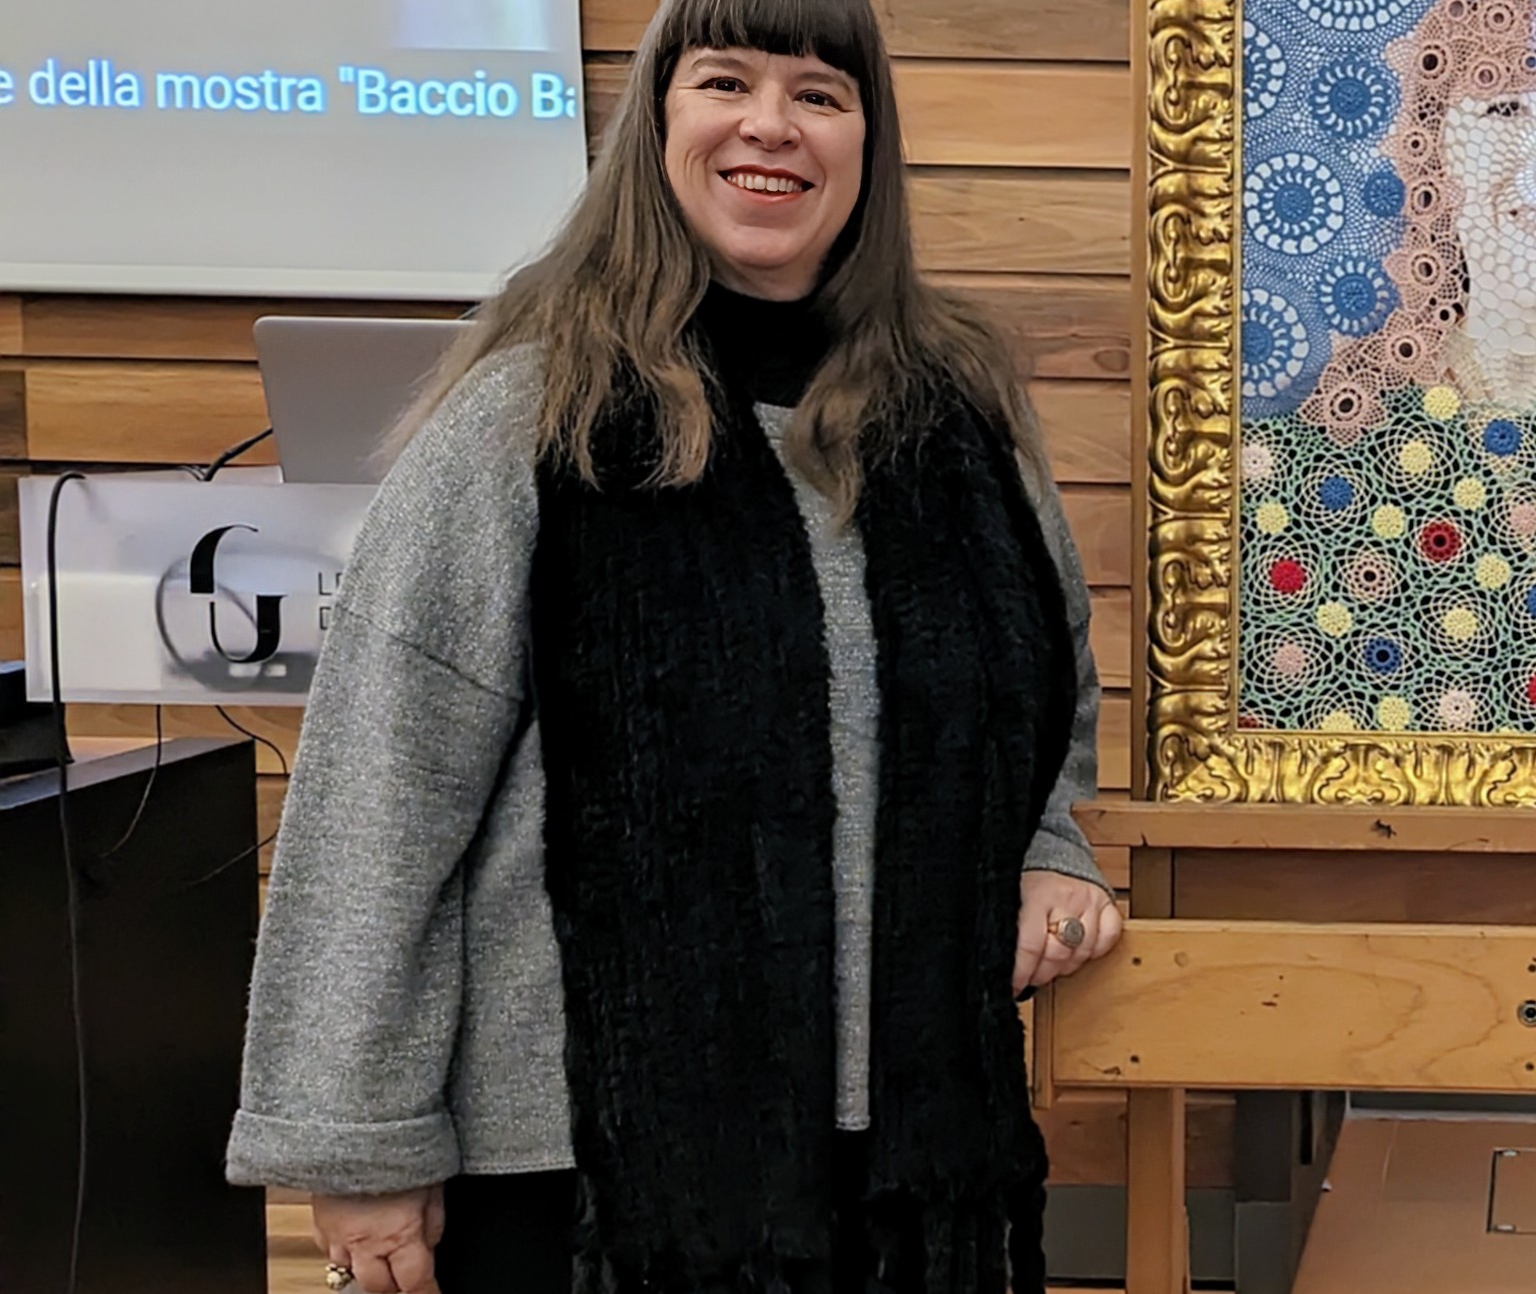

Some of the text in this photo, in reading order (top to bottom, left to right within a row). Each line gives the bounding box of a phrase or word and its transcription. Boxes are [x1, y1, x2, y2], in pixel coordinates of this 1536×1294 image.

[28, 58, 141, 107] della
[156, 69, 325, 112] mostra
[338, 65, 518, 117] "Baccio
